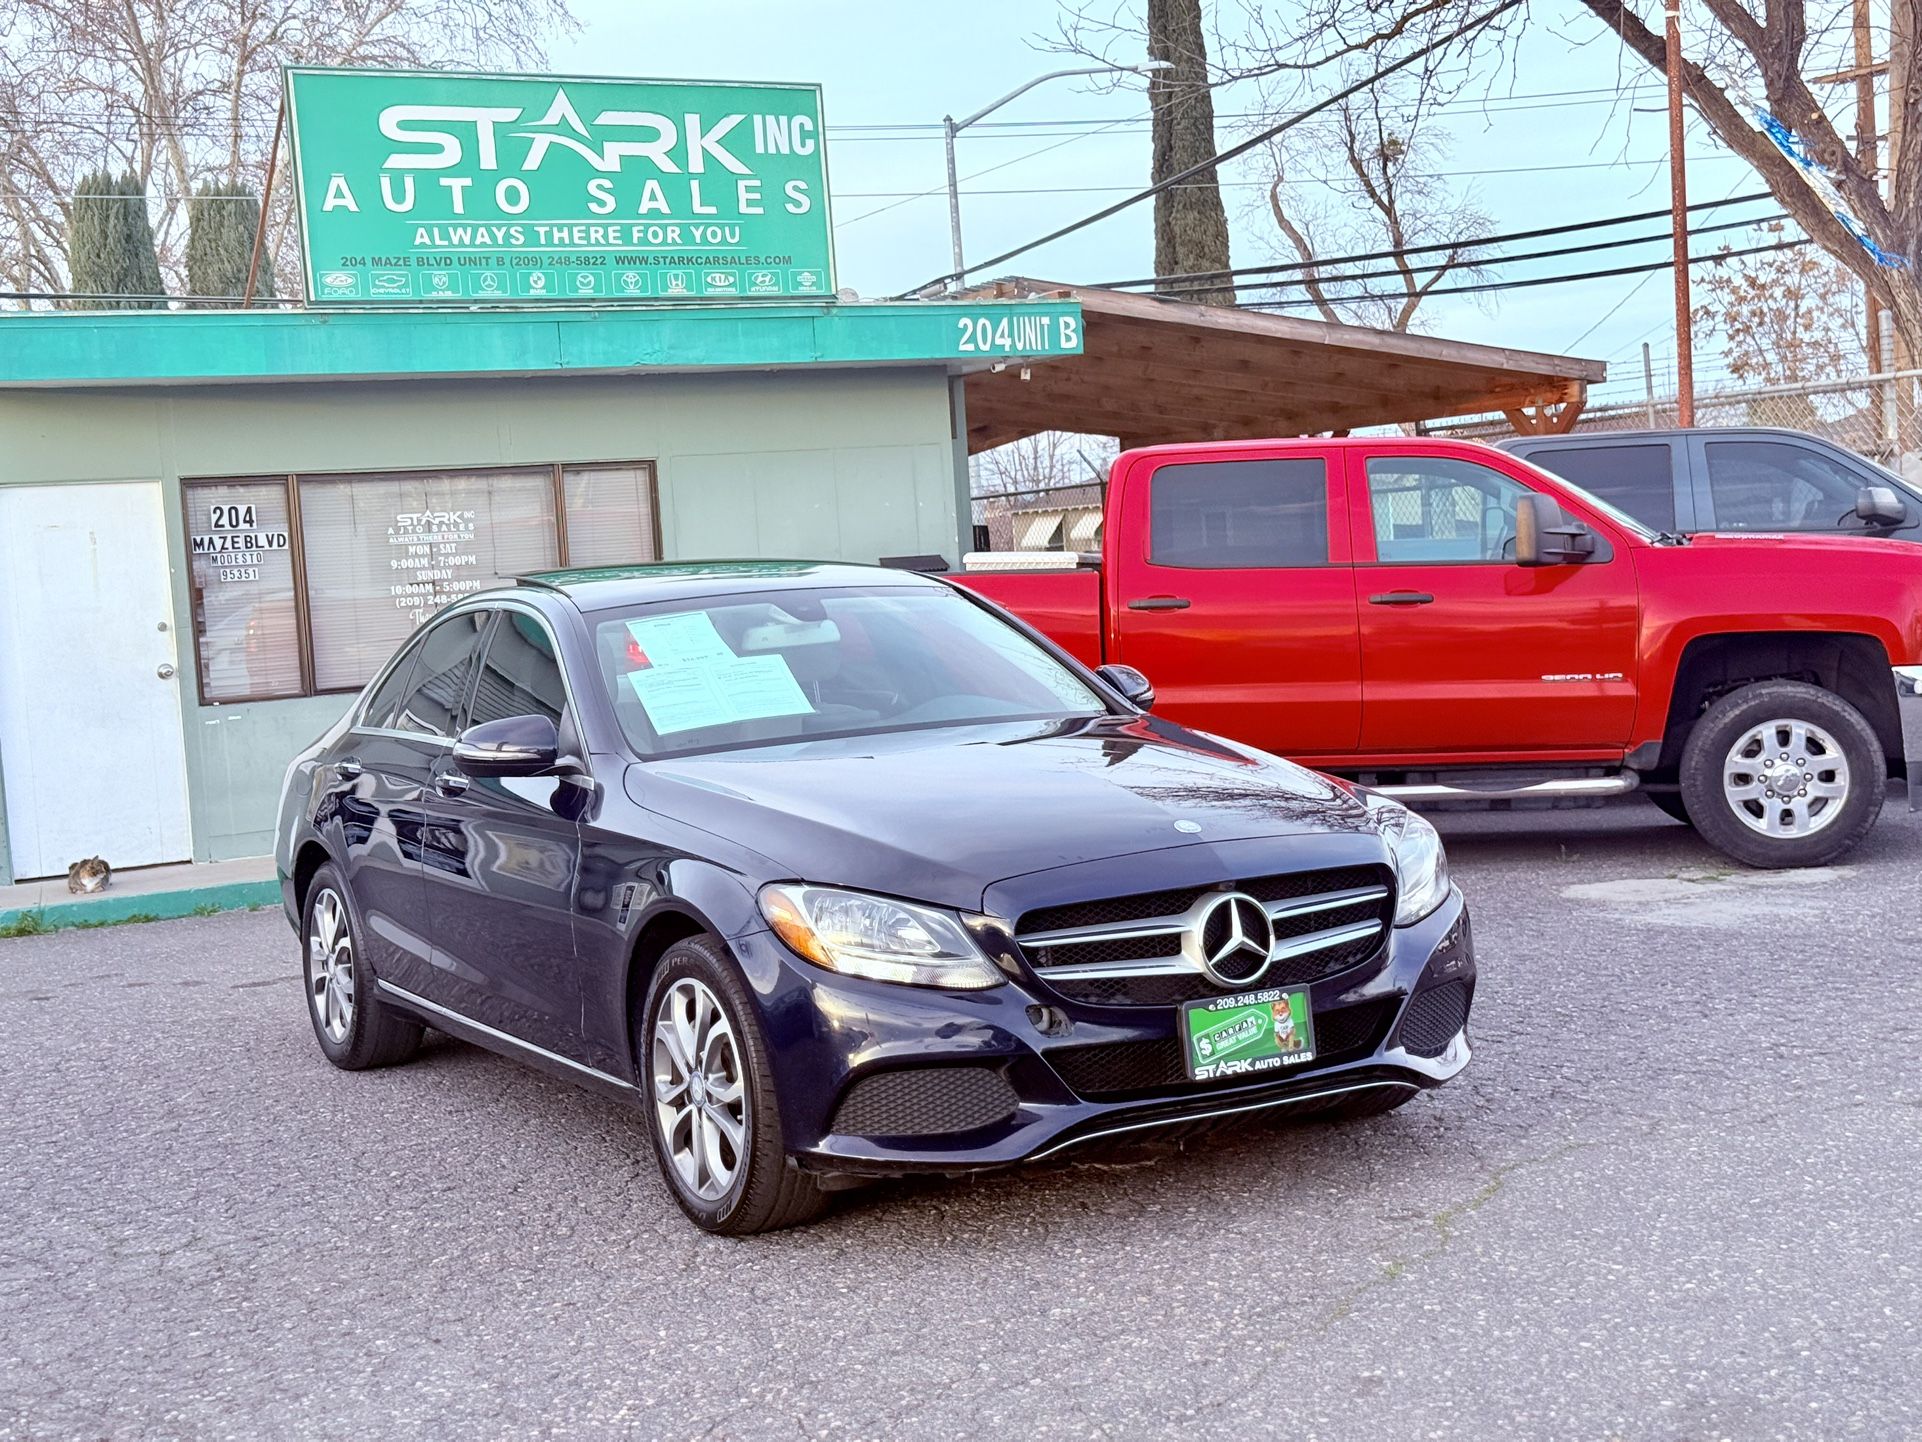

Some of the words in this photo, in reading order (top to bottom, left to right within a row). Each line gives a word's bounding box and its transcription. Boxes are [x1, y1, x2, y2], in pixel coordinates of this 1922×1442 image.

[378, 85, 757, 175] STARK
[752, 114, 816, 155] INC
[321, 173, 531, 215] AUTO
[586, 178, 812, 215] SALES
[413, 226, 526, 246] ALWAYS
[533, 225, 623, 246] THERE
[632, 225, 683, 245] FOR
[690, 225, 740, 244] YOU
[340, 256, 367, 267] 204
[371, 256, 412, 267] MAZE
[416, 256, 453, 267] BLVD
[457, 256, 491, 267] UNIT
[496, 256, 506, 266] B
[509, 255, 544, 269] (209)
[547, 255, 607, 267] 248-5822
[614, 255, 793, 266] WWW.STARKCARSALES.COM
[958, 316, 1012, 352] 204
[1013, 316, 1051, 351] UNIT
[1059, 316, 1078, 349] B
[212, 505, 255, 529] 204
[396, 509, 464, 527] STARK
[431, 522, 475, 533] SALES
[389, 535, 418, 543] ALWAYS
[460, 532, 475, 541] YOU
[408, 544, 430, 556] MON
[439, 543, 457, 554] SAT
[211, 552, 263, 566] MODESTO
[390, 557, 429, 570] 9:00AM
[438, 555, 477, 567] 7:00PM
[222, 569, 258, 581] 95351
[416, 569, 453, 581] SUNDAY
[390, 583, 434, 596] 10:00AM
[442, 579, 481, 593] 5:00PM
[395, 596, 424, 609] (209)
[1216, 989, 1281, 1010] 209.248.5822
[1194, 1058, 1254, 1081] STARK
[1254, 1057, 1281, 1071] AUTO
[1282, 1051, 1313, 1066] SALES
